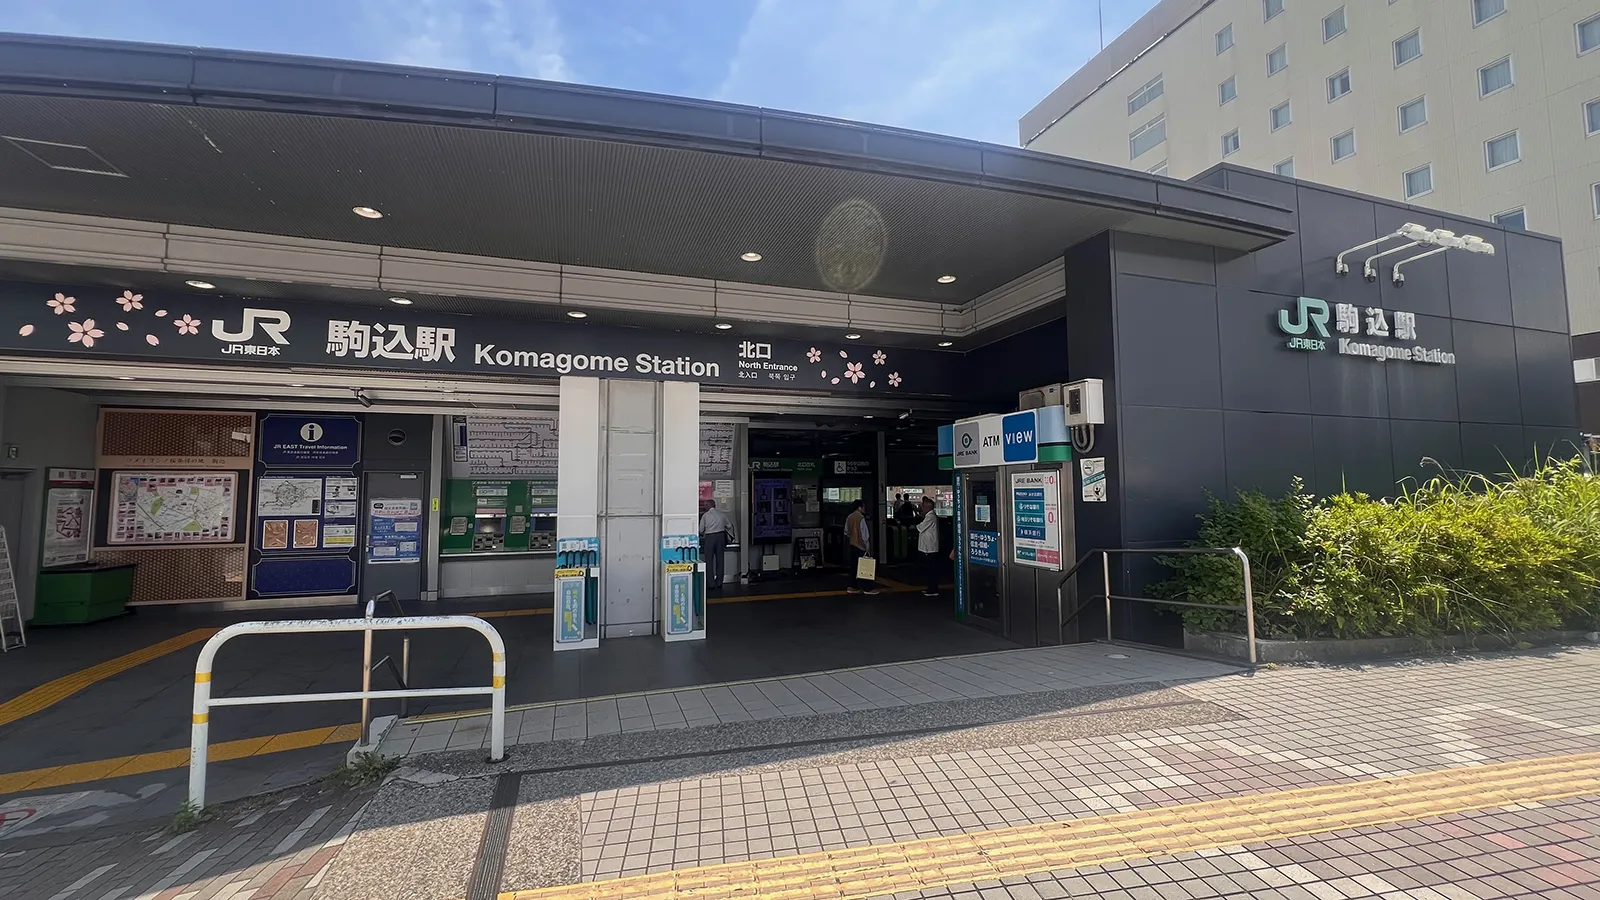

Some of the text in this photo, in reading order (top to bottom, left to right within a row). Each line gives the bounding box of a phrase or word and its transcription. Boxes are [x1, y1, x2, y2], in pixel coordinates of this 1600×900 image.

[1278, 296, 1331, 338] JR
[1335, 303, 1417, 340] 駒込駅
[212, 308, 291, 345] JR
[221, 344, 281, 356] JR東日本
[326, 319, 457, 363] 駒込駅
[738, 341, 771, 359] 北口
[1288, 337, 1326, 350] JR東日本
[1338, 337, 1456, 364] Komagome Station
[474, 343, 720, 377] Komagome Station
[738, 360, 798, 372] North Entrance
[738, 371, 758, 379] 北入口
[983, 435, 1000, 447] ATM
[748, 461, 760, 469] JR
